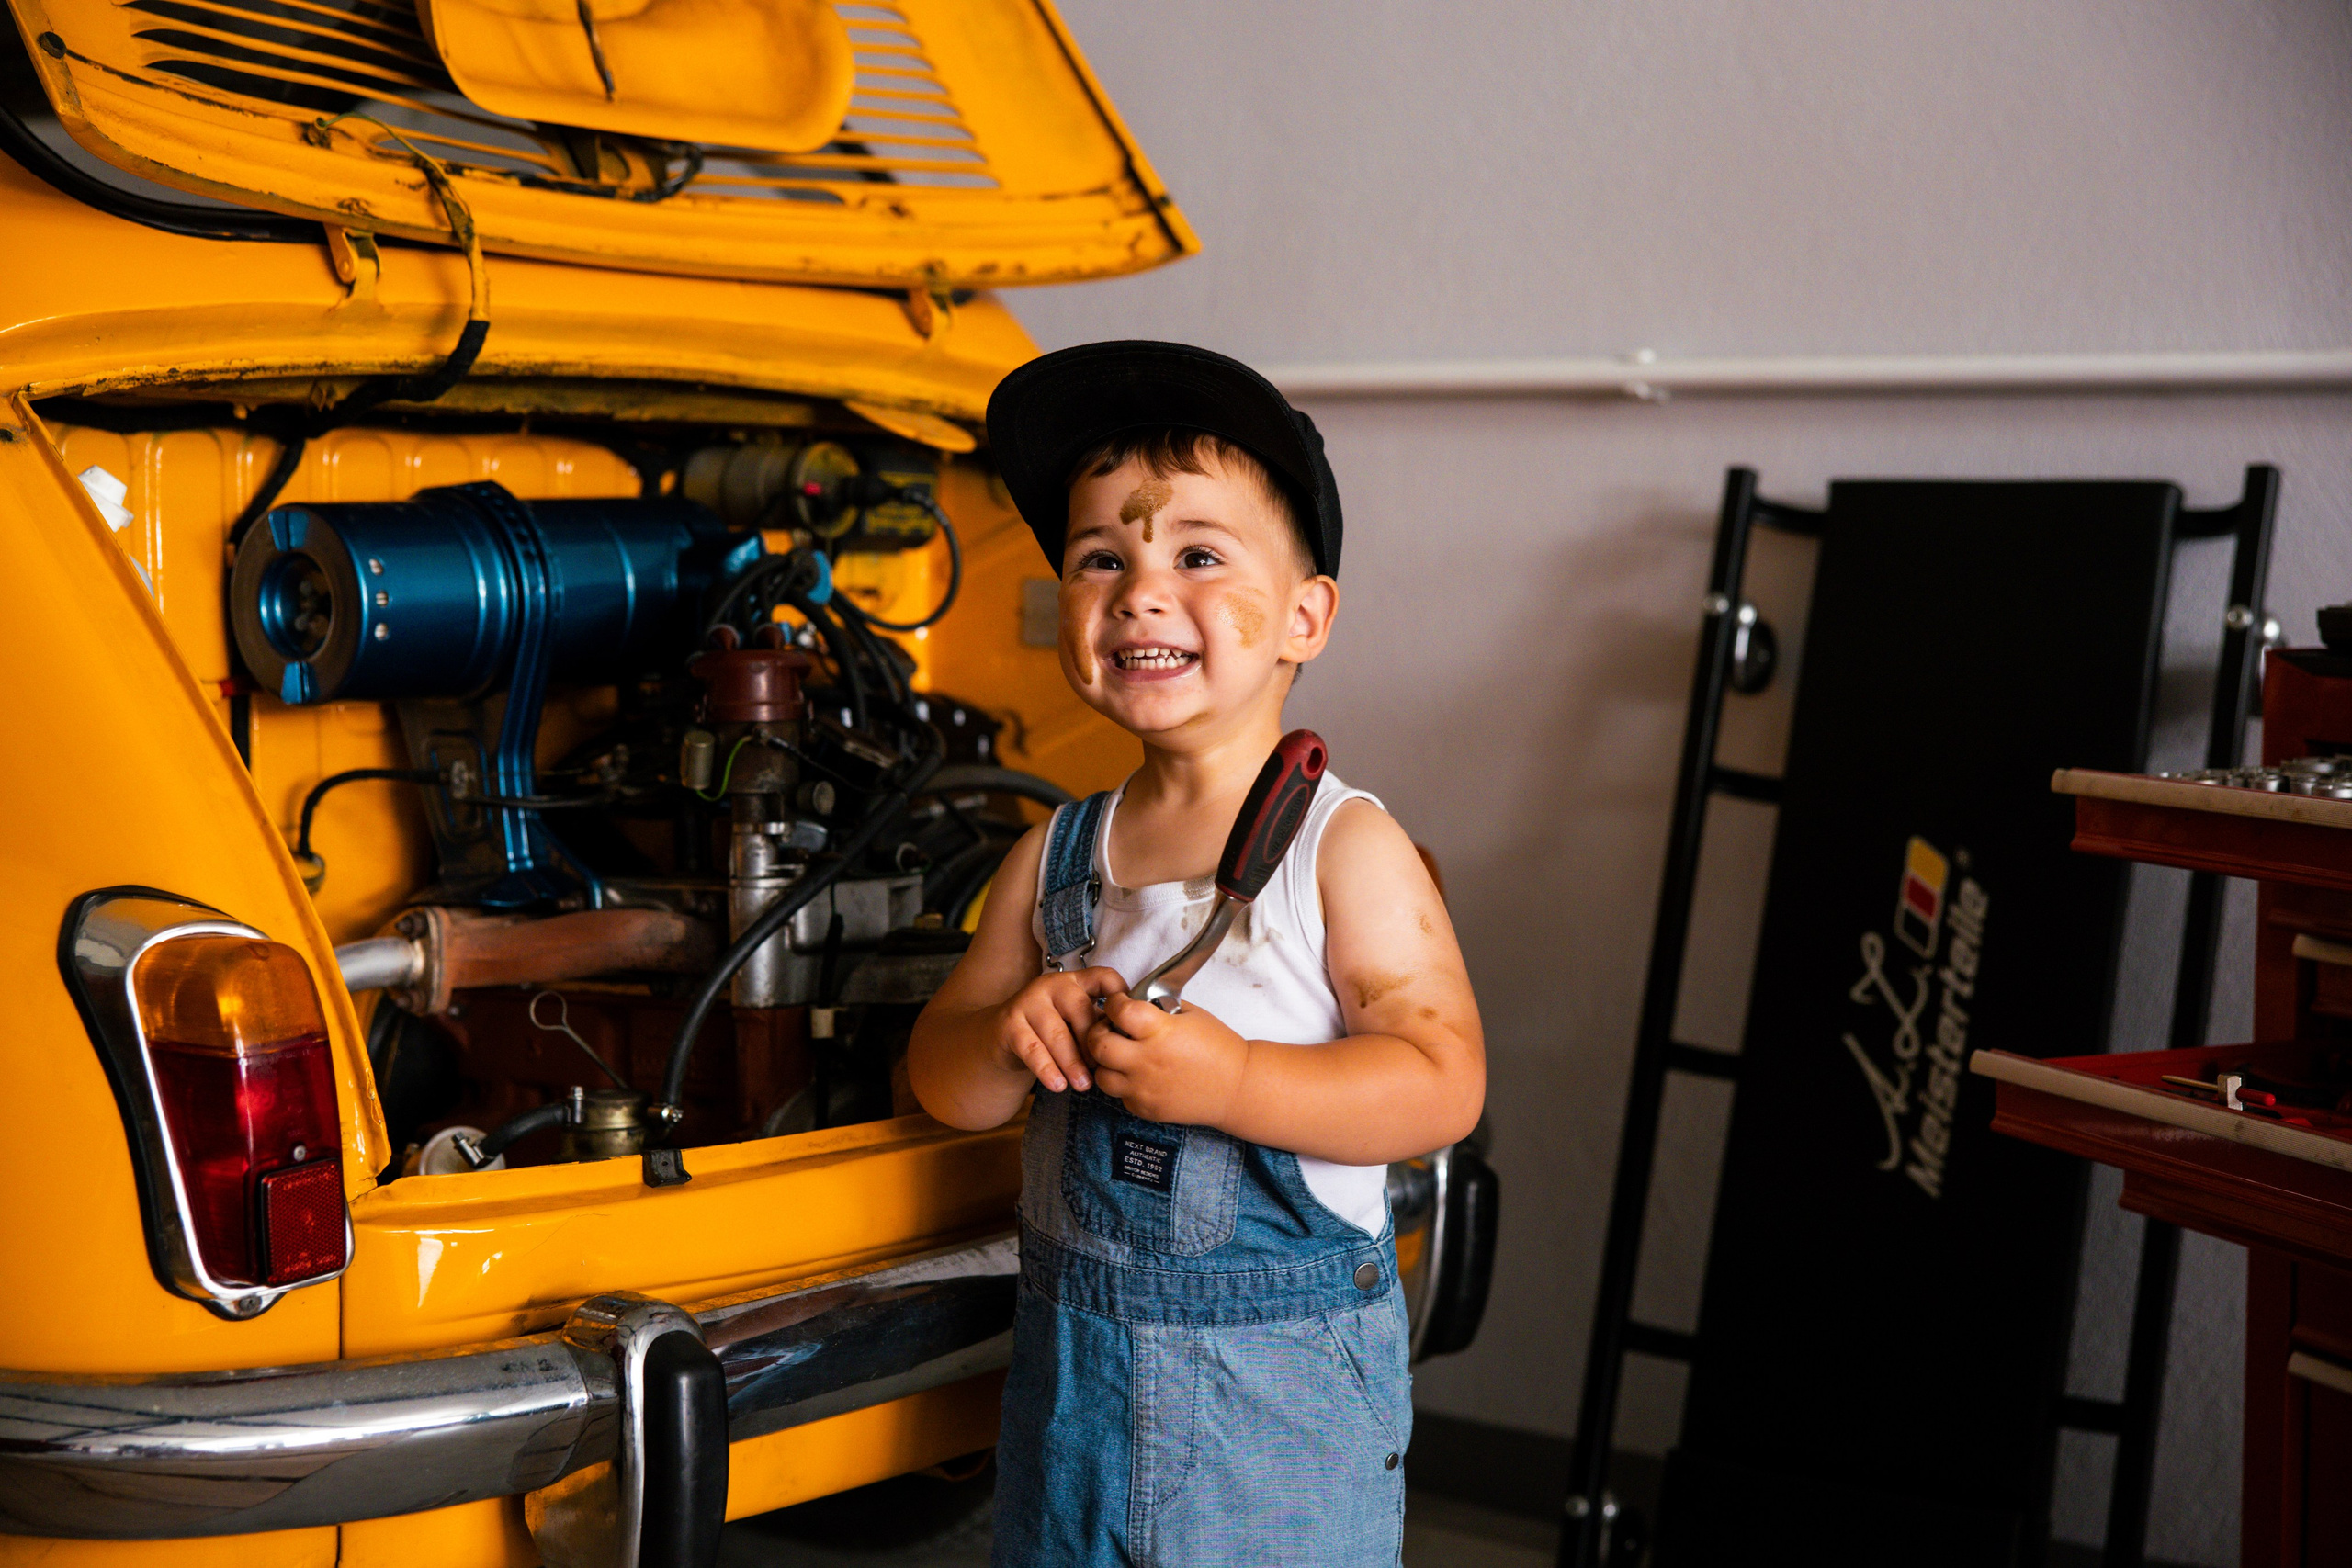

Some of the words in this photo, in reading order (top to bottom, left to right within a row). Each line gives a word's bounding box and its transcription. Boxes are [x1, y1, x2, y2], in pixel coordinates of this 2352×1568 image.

[1905, 877, 1989, 1198] Meisterteile
[1125, 1140, 1144, 1150] NEXT
[1145, 1145, 1168, 1157] BRAND
[1124, 1156, 1145, 1168] ESTD.
[1129, 1150, 1162, 1164] AUTHENTIC
